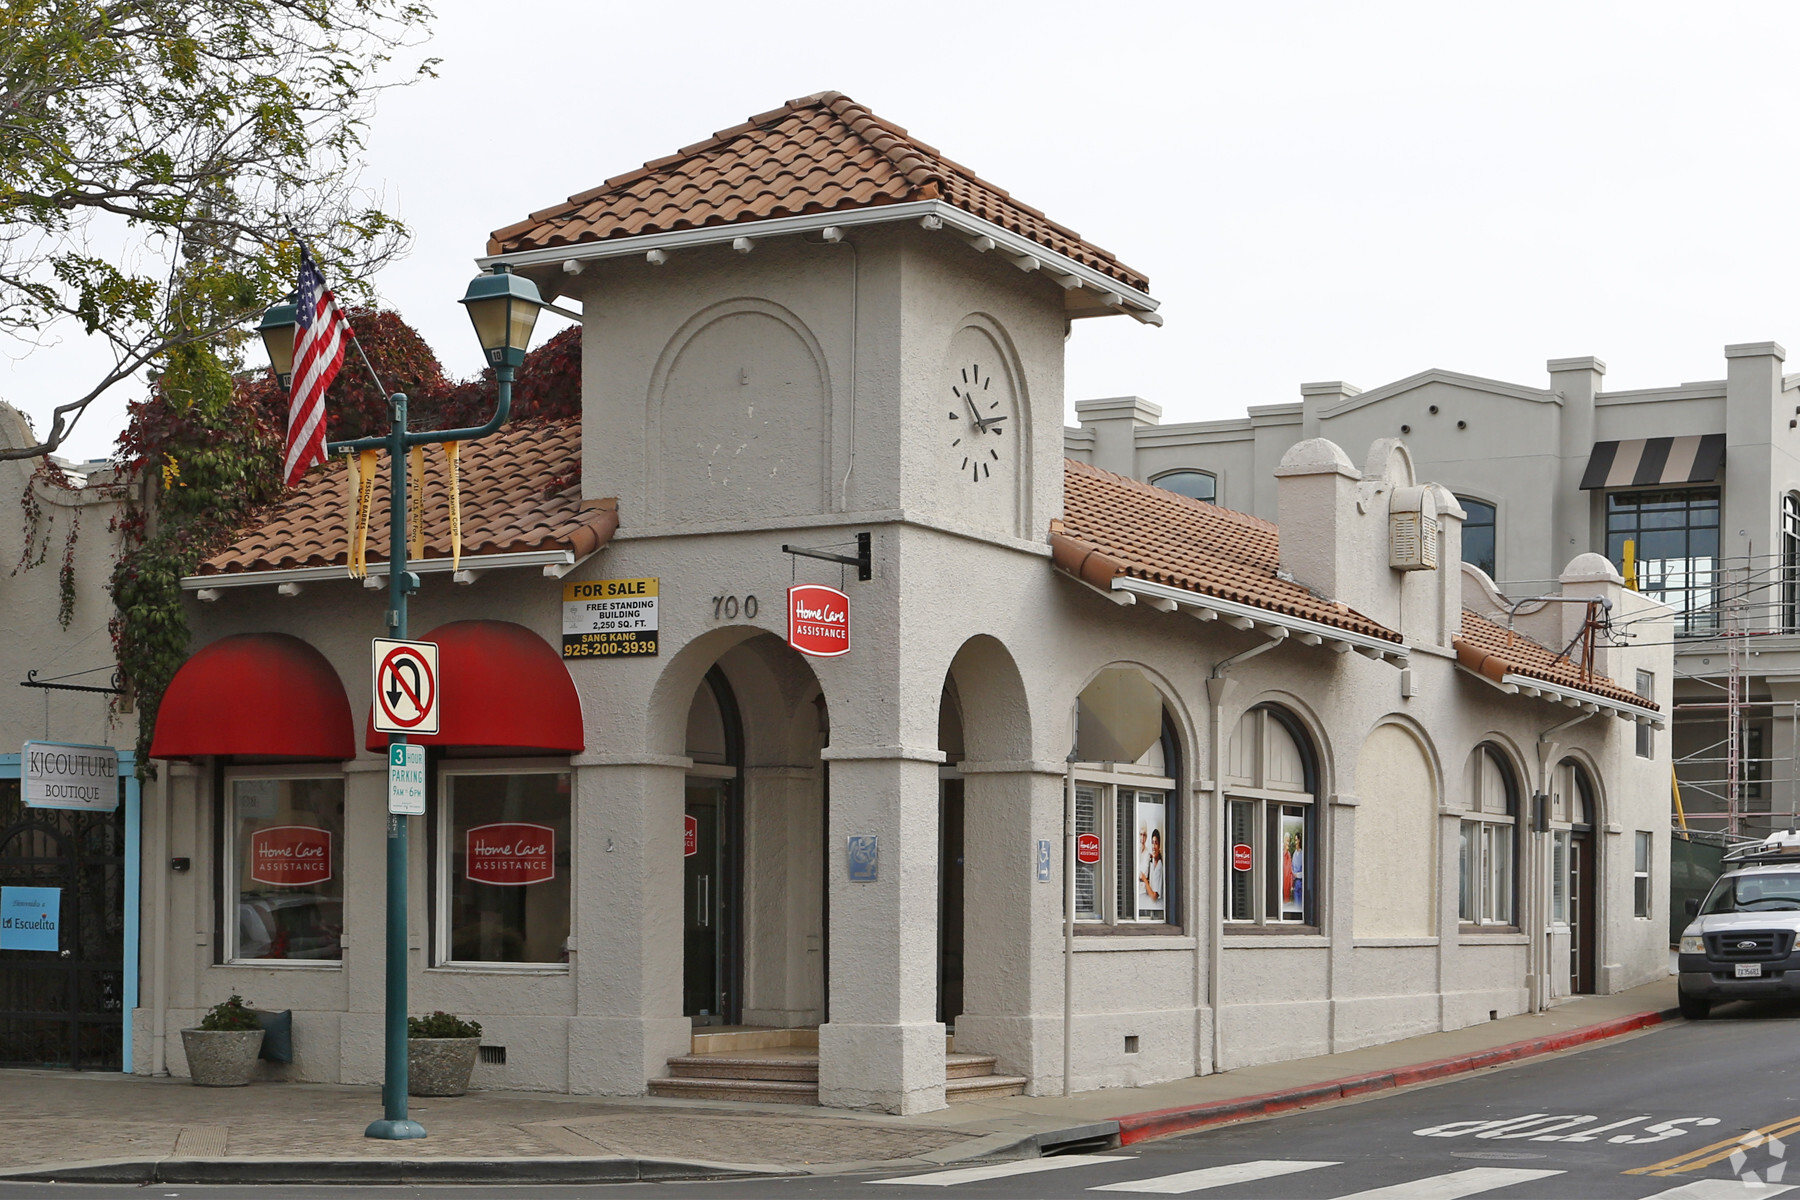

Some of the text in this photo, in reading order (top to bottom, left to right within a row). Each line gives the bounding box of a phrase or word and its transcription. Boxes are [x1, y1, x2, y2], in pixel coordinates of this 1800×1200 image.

[363, 478, 372, 503] JESSICA
[574, 582, 646, 597] FOR SALE
[586, 601, 654, 611] FREE STANDING
[712, 595, 758, 620] 700
[796, 600, 845, 623] Home Care
[599, 610, 640, 619] BUILDING
[593, 620, 647, 630] 2,250 SQ. FT.
[797, 625, 846, 639] ASSISTANCE
[582, 632, 636, 643] SANG KANG
[564, 641, 656, 656] 925-200-3939
[395, 749, 423, 764] 3 HOUR
[30, 751, 115, 778] KJCOUTURE
[392, 769, 423, 783] PARKING
[45, 784, 100, 803] BOUTIQUE
[259, 841, 324, 857] Home Care
[474, 839, 547, 856] Home Care
[259, 862, 325, 871] ASSISTANCE
[475, 861, 547, 870] ASSISTANCE
[15, 914, 55, 930] Escuelita
[1412, 1113, 1722, 1144] STOP
